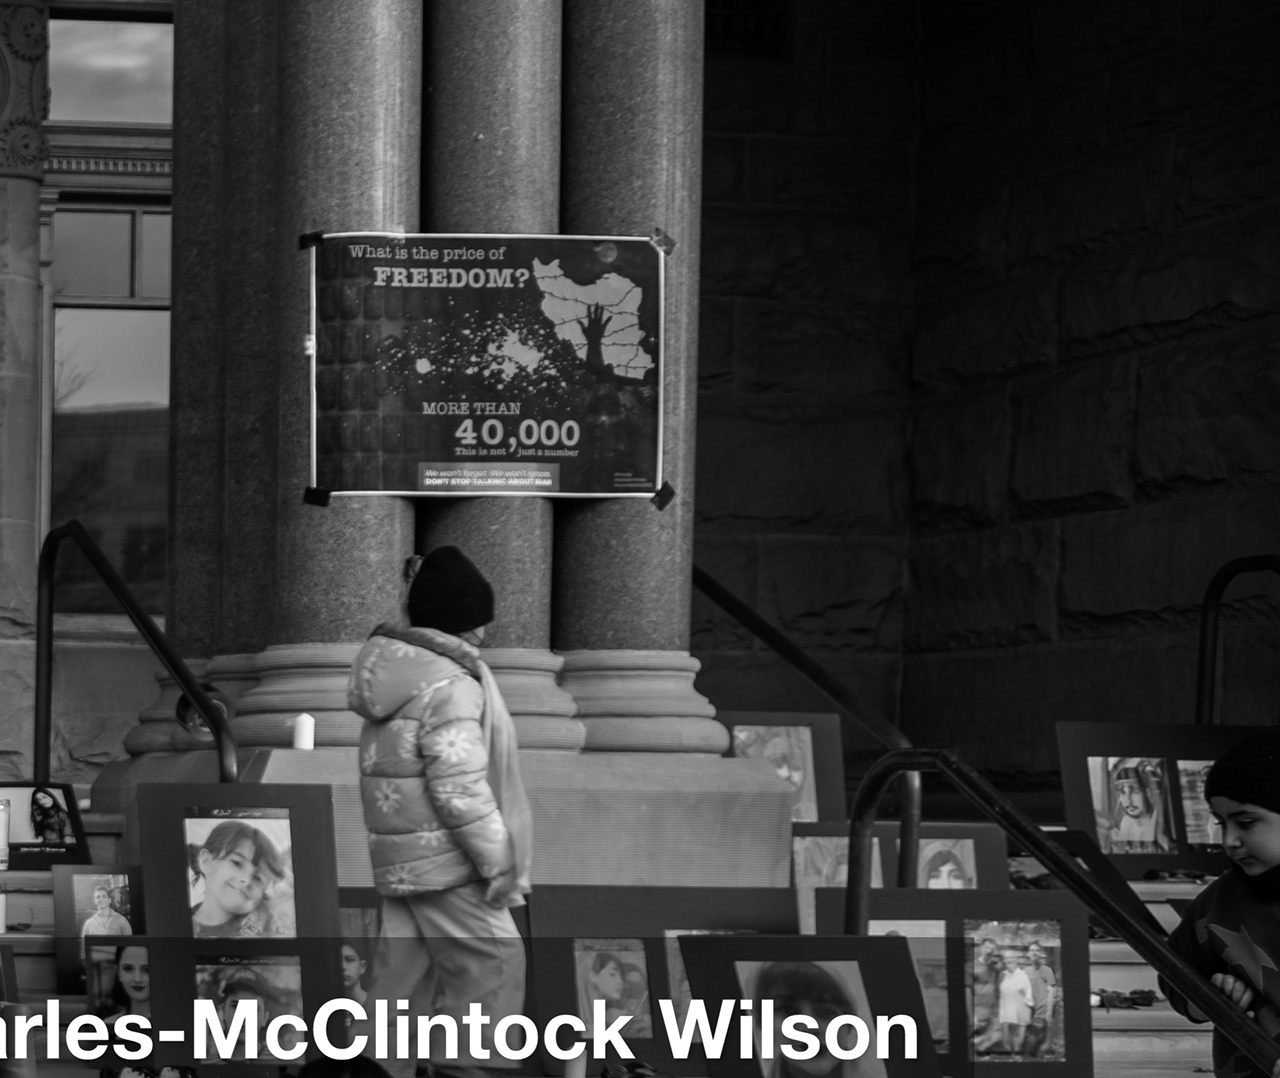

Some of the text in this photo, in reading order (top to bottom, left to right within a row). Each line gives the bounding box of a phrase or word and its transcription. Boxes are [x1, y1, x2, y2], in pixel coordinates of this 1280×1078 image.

[348, 243, 507, 264] What is the price of
[373, 265, 531, 289] FREEDOM?
[422, 401, 522, 416] MORE THAN
[454, 418, 581, 451] 40,000
